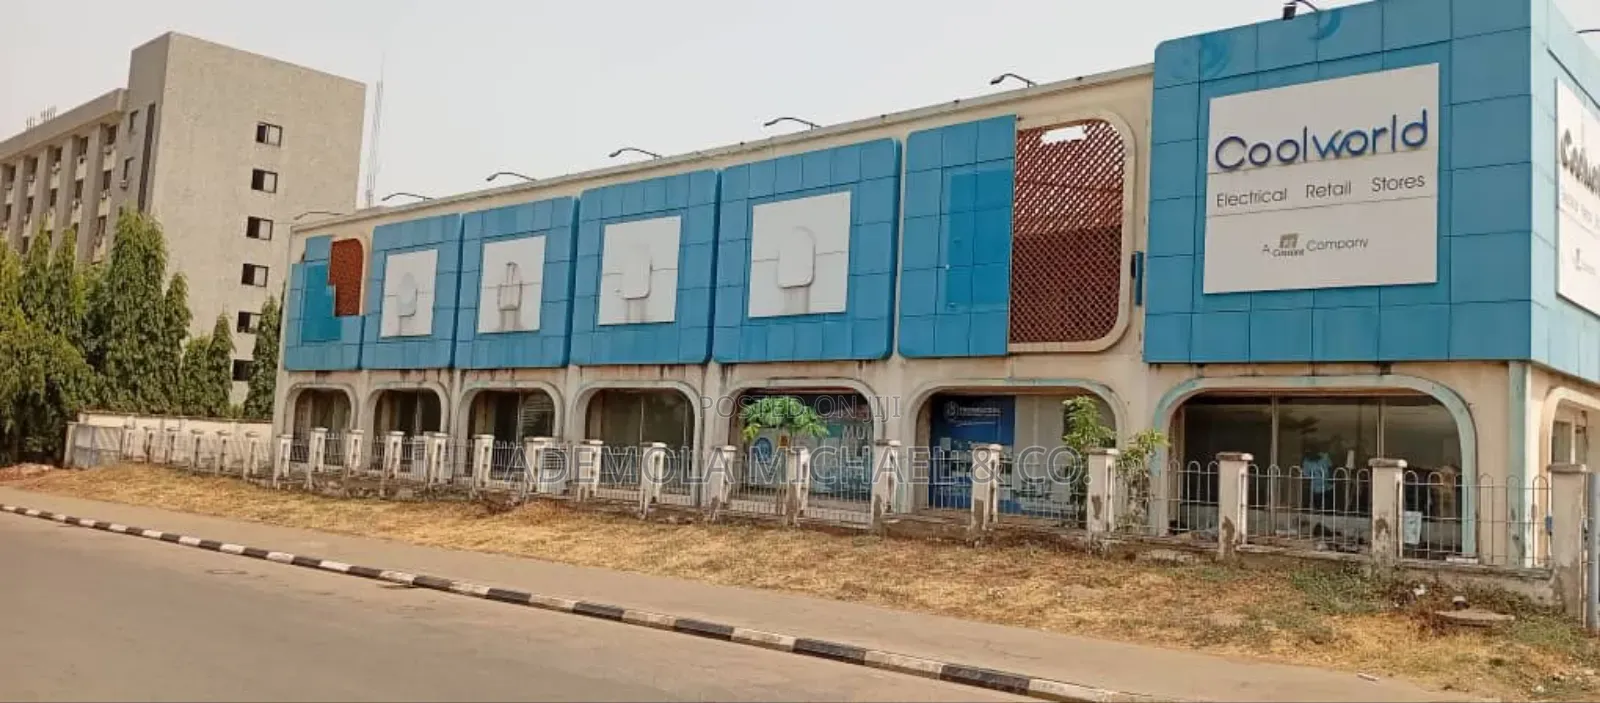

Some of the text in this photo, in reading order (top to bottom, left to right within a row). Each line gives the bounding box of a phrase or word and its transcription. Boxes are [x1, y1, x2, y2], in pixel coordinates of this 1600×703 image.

[1215, 109, 1428, 171] Coolworld
[1216, 174, 1425, 208] Electrical Retail Stores
[1306, 237, 1369, 252] Company
